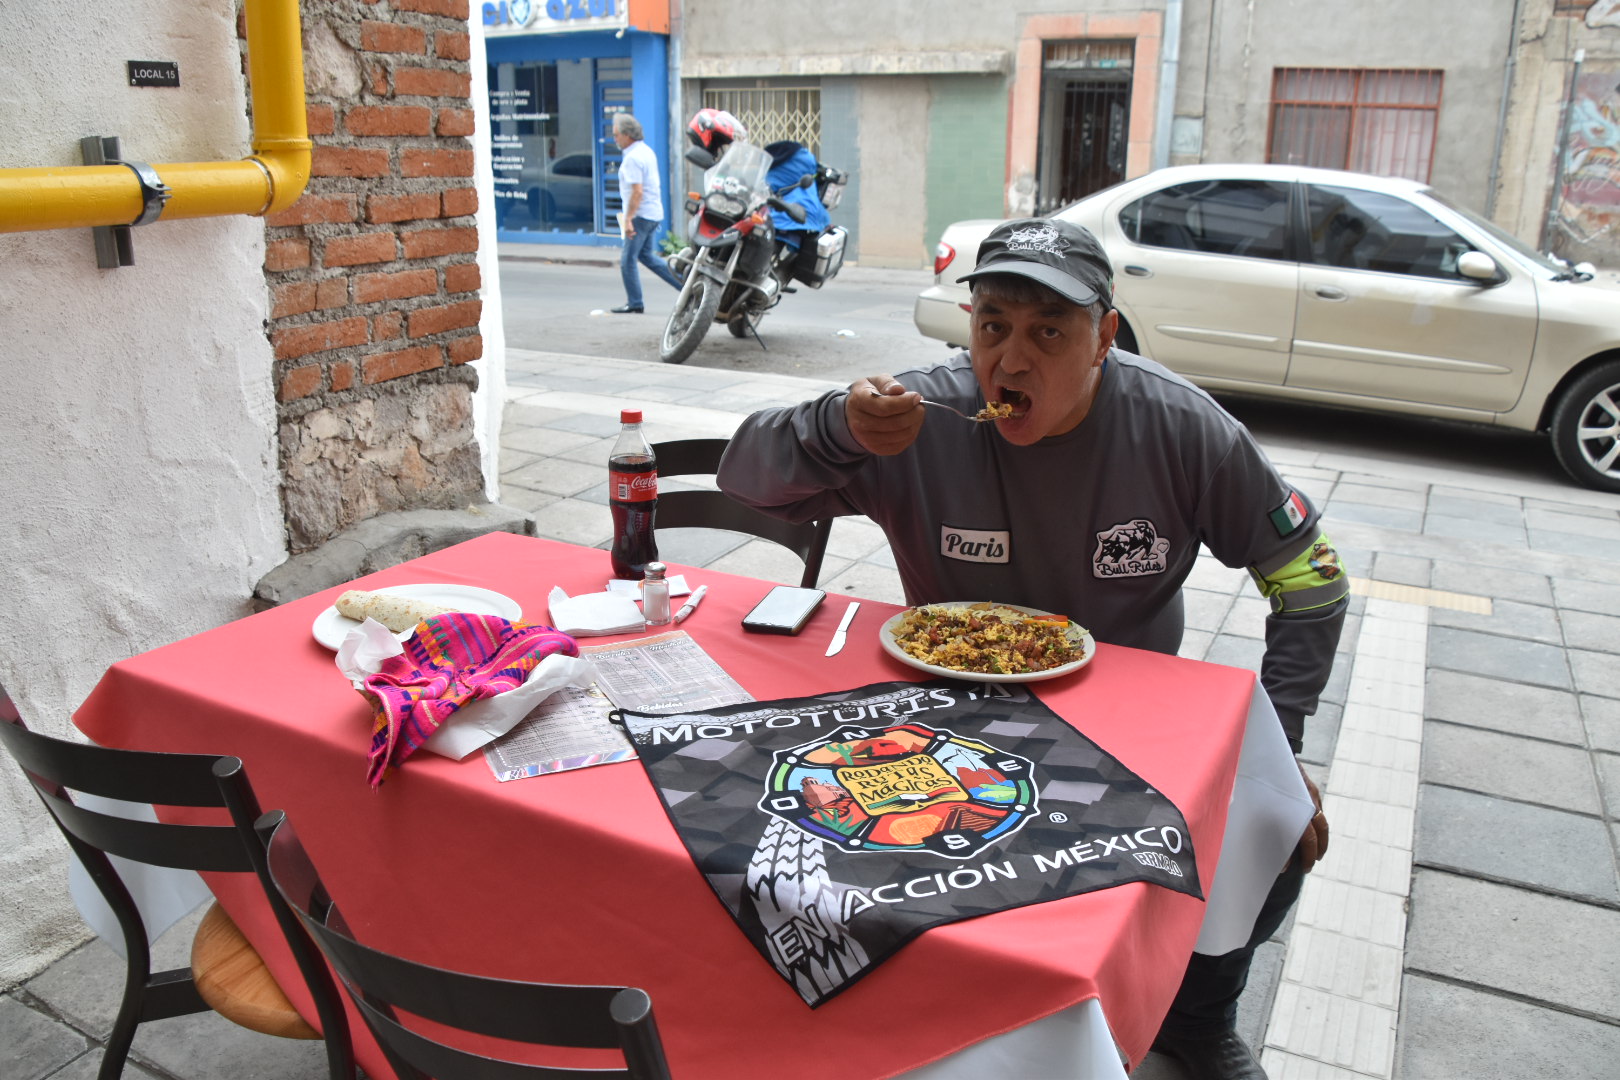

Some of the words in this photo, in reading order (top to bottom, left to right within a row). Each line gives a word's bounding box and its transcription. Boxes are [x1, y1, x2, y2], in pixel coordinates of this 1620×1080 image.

[134, 69, 164, 79] LOCAL
[166, 70, 176, 79] 15
[1007, 241, 1034, 251] Bull
[945, 533, 1004, 558] Paris
[1097, 563, 1129, 576] Bull
[636, 701, 684, 713] Bebidas
[772, 904, 829, 967] EN
[843, 860, 1018, 925] ACCIÓN
[1032, 825, 1183, 873] MÉXICO
